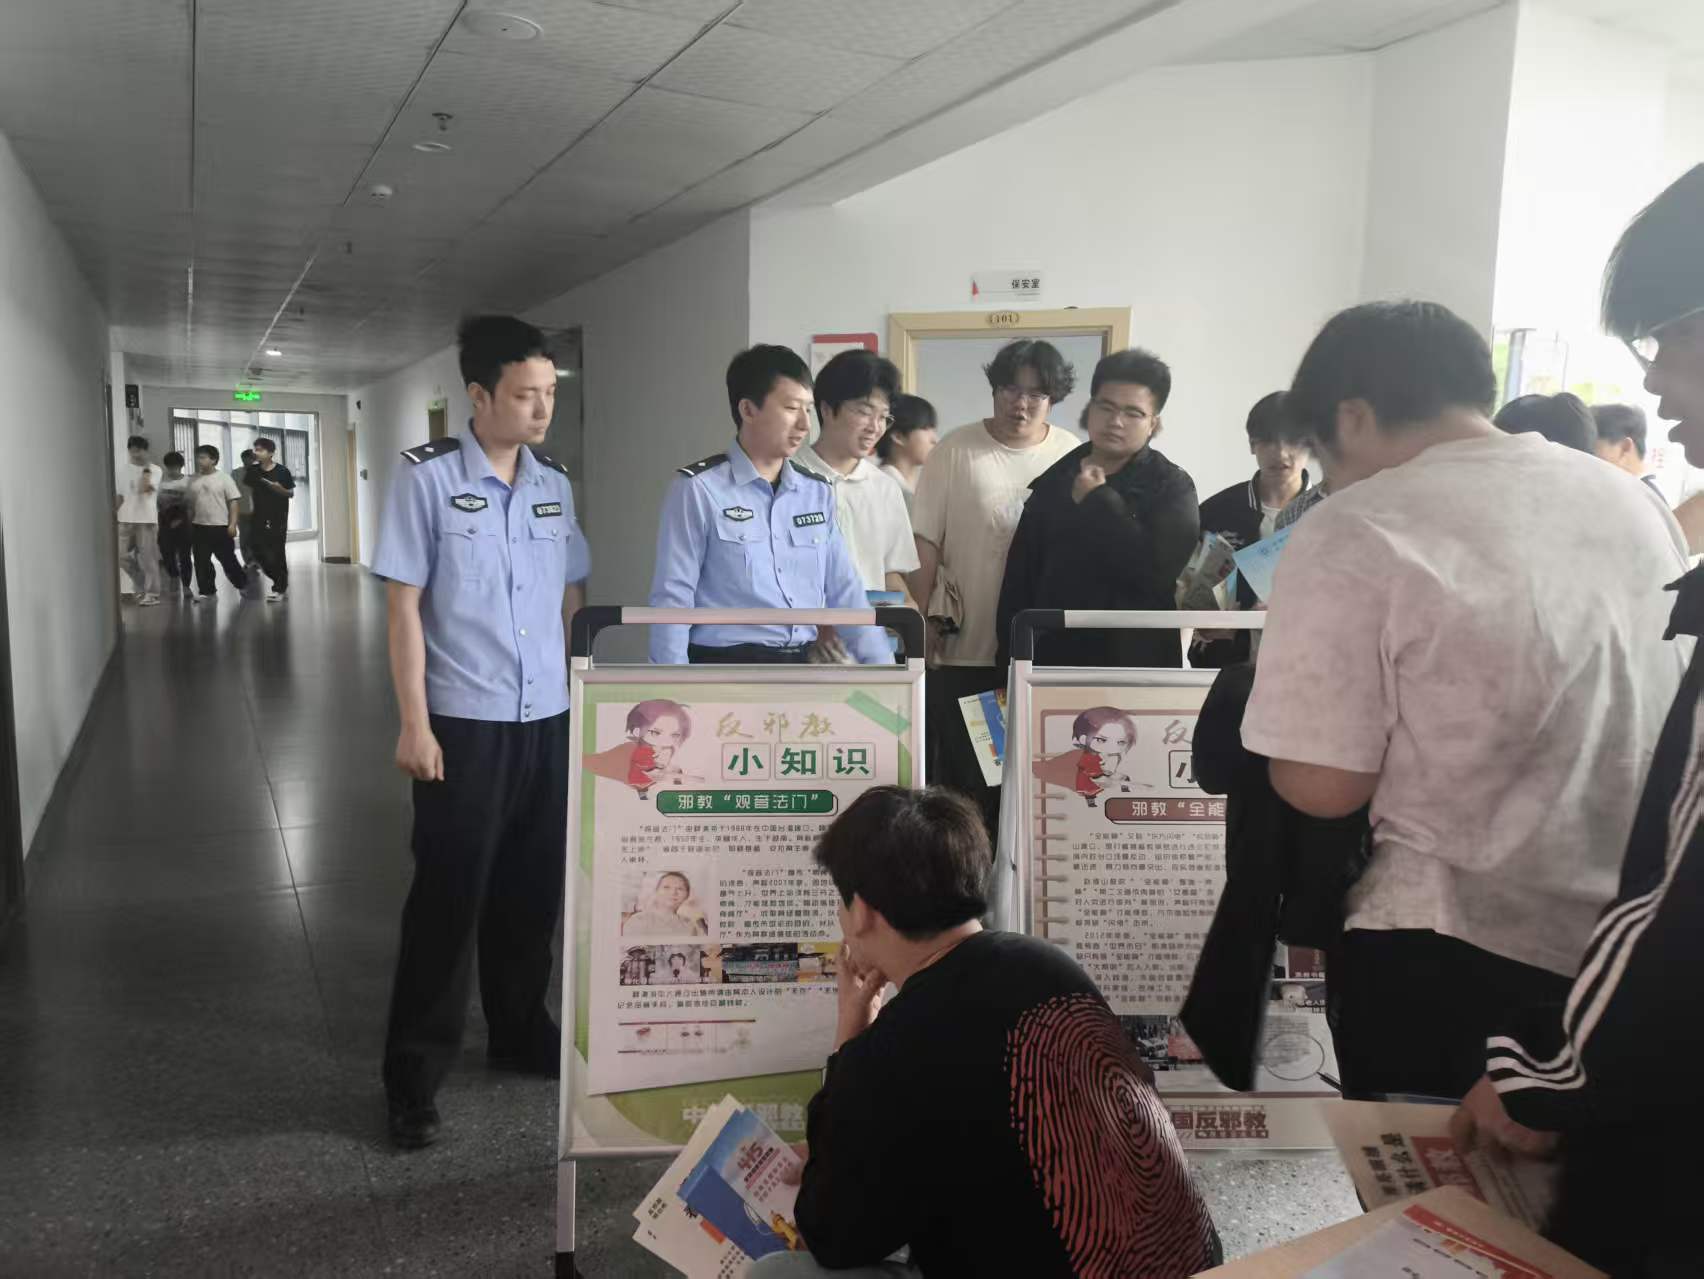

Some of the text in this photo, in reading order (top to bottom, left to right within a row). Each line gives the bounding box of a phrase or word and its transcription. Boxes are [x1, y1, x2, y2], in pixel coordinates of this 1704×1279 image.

[1011, 278, 1040, 289] 保安室
[716, 712, 836, 743] 反邪教
[727, 747, 870, 776] 小知识
